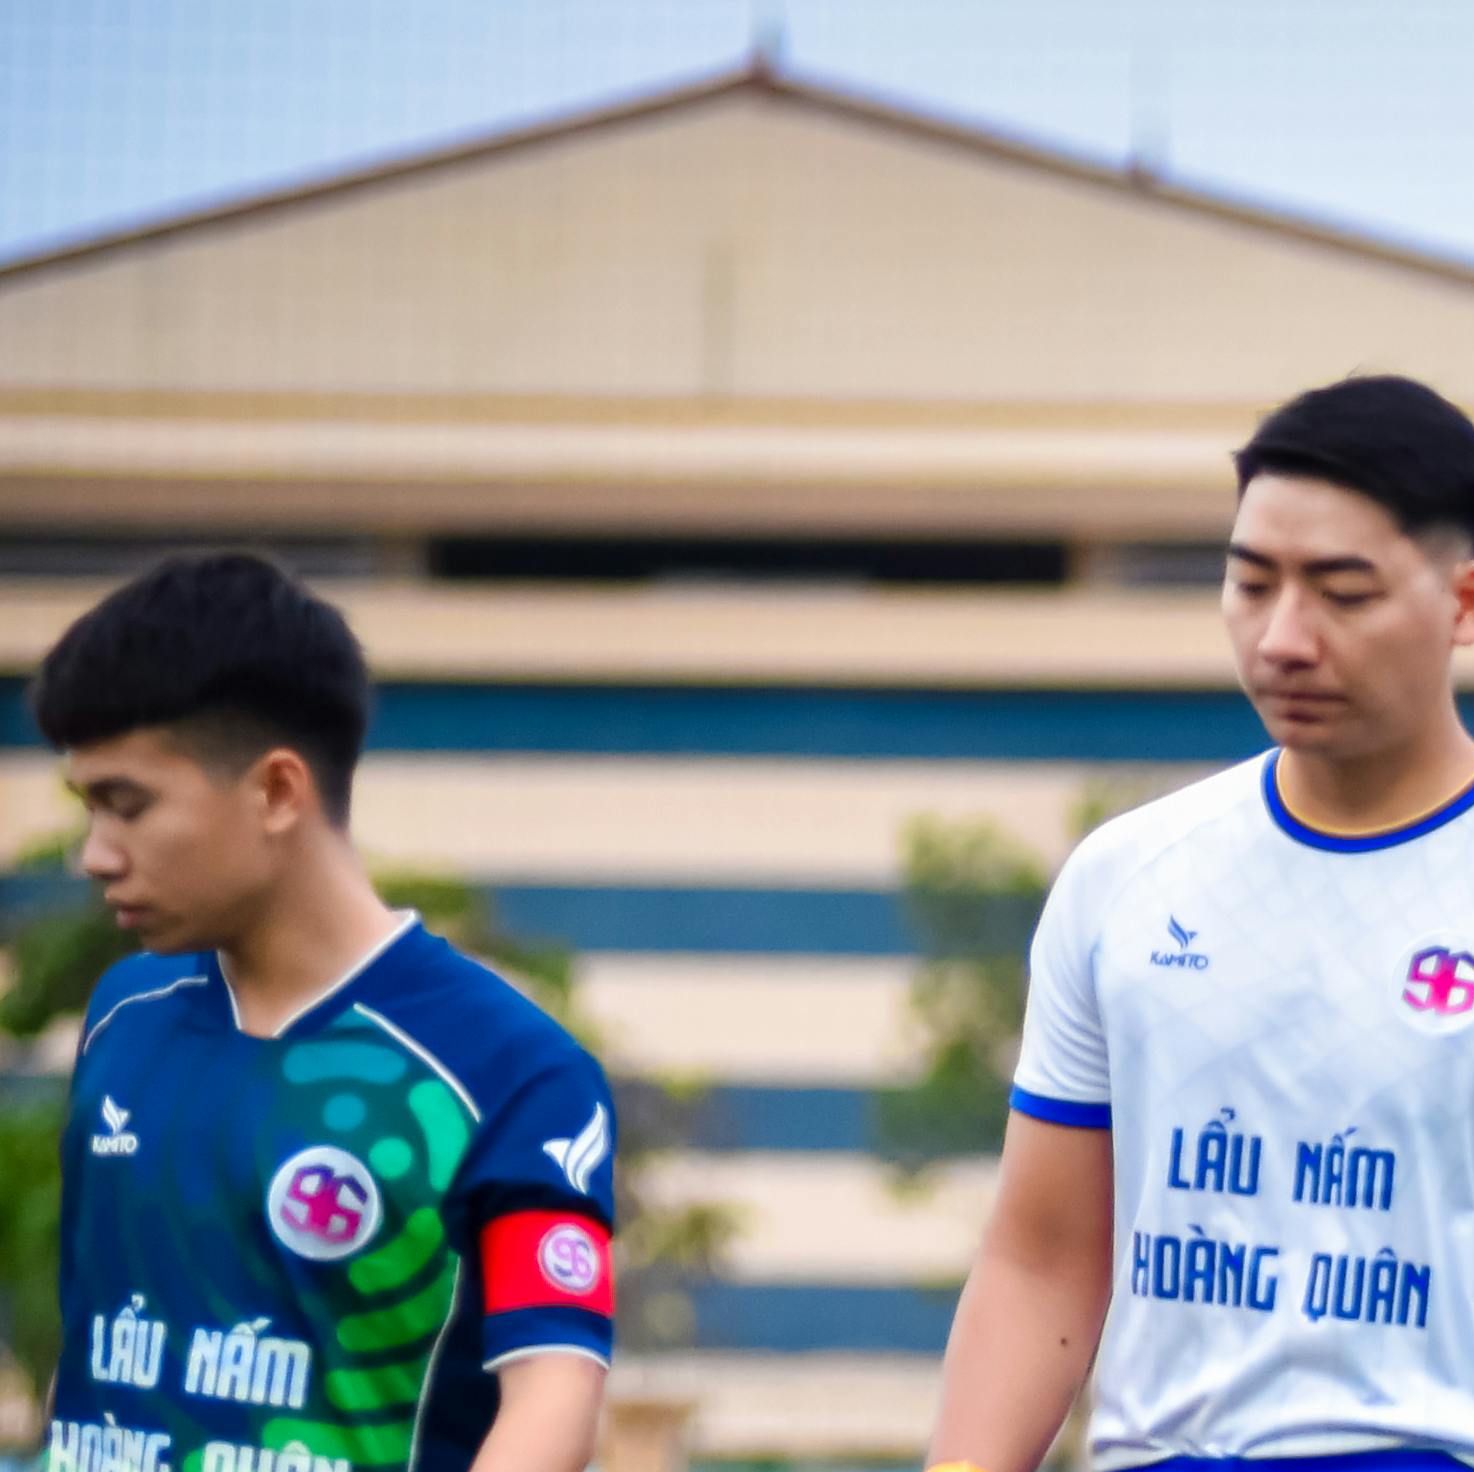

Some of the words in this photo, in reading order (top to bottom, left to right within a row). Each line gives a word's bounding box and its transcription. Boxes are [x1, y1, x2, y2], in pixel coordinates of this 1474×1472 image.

[1150, 950, 1209, 970] KAMITO
[1168, 1108, 1262, 1196] LẨU
[1293, 1127, 1395, 1211] NẤM
[1133, 1225, 1279, 1313] HOÀNG
[1303, 1247, 1431, 1329] QUÂN
[92, 1295, 165, 1389] LẨU
[184, 1317, 311, 1409] NẤM
